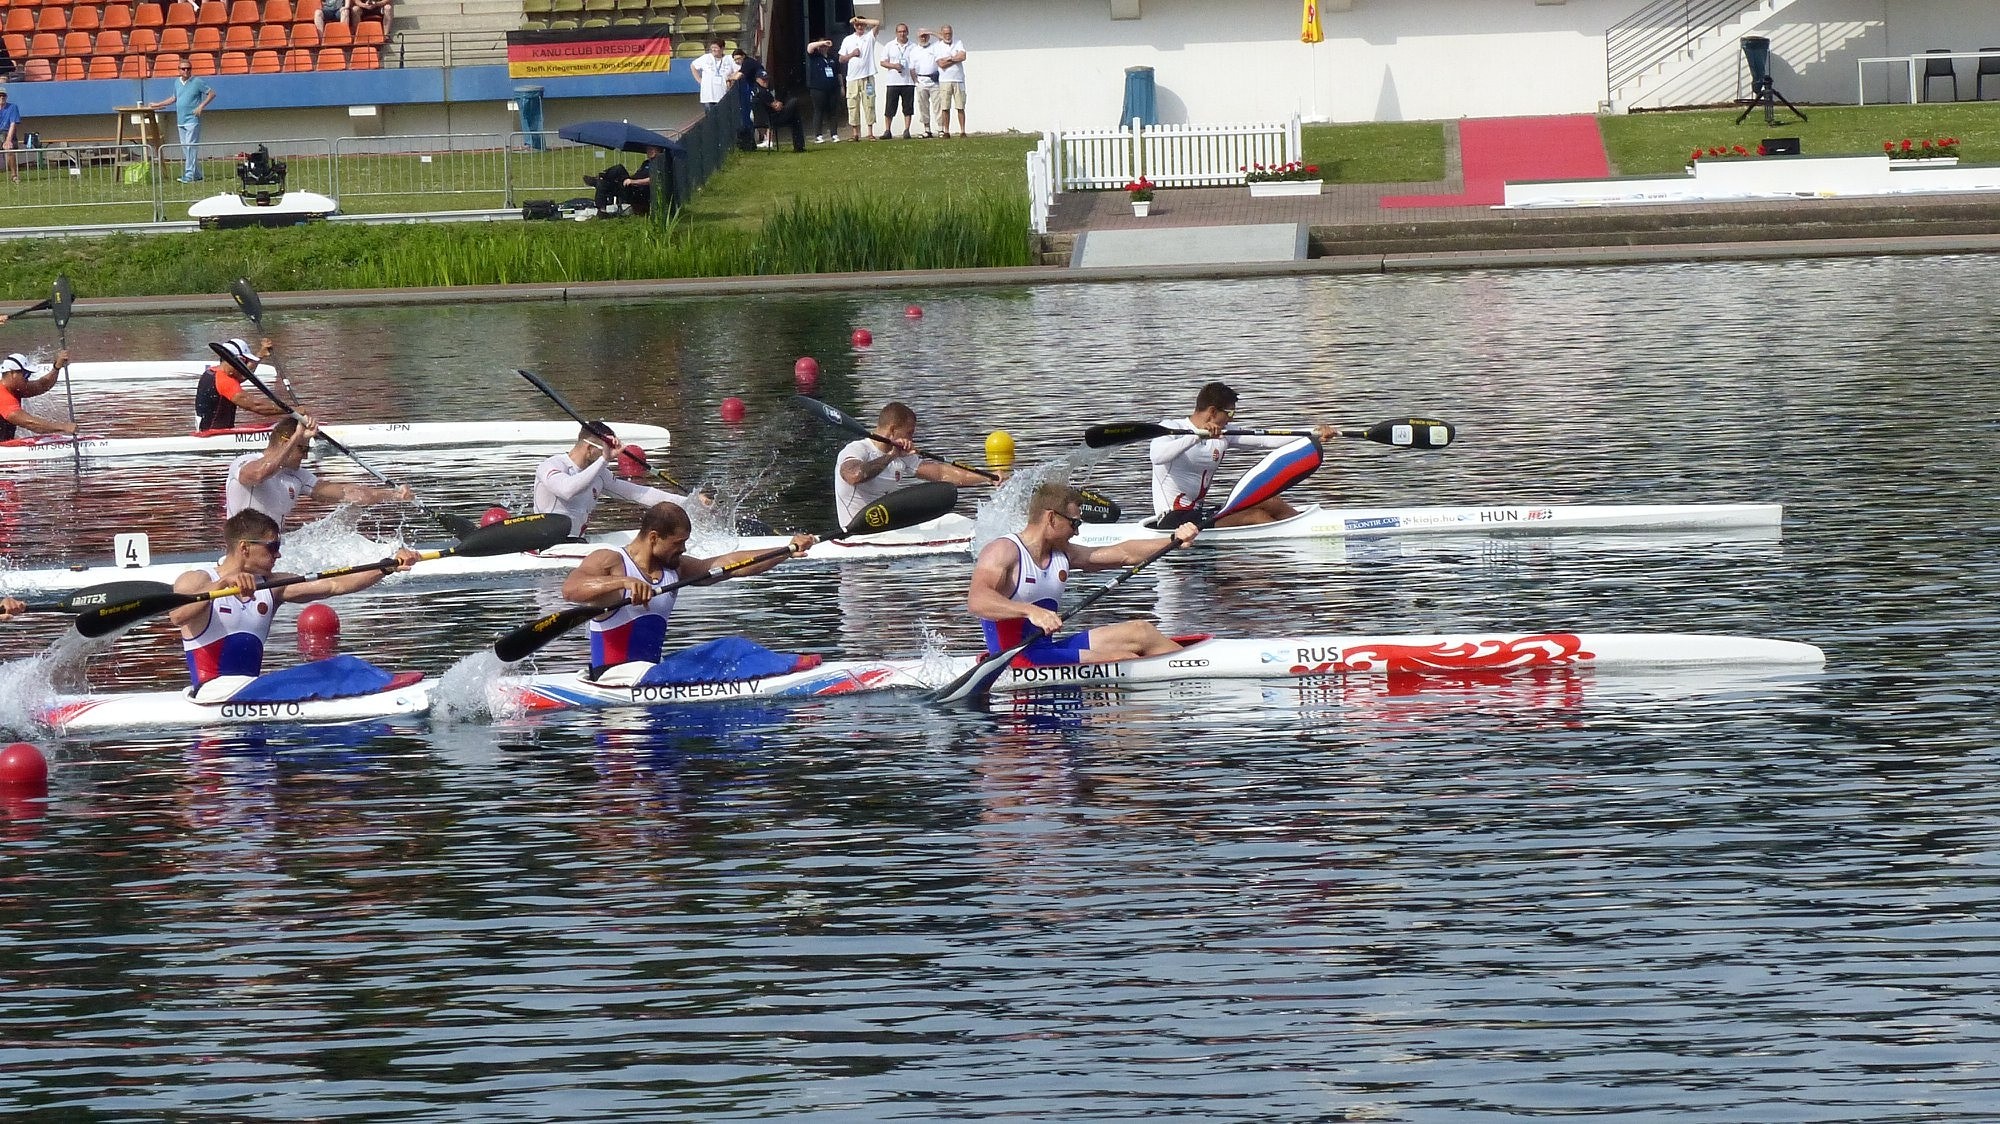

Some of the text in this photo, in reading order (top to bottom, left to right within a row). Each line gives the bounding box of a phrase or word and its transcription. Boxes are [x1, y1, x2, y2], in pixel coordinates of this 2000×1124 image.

[532, 44, 646, 58] KANU CLUB DRESDEN
[386, 424, 411, 432] JPN
[235, 432, 270, 443] MIZUM
[1081, 504, 1110, 513] TIR.COM
[1480, 510, 1518, 522] HUN
[126, 539, 138, 561] 4
[1297, 646, 1339, 663] RUS
[631, 680, 763, 702] POGREBAN V.
[221, 702, 305, 718] GUSEV O.
